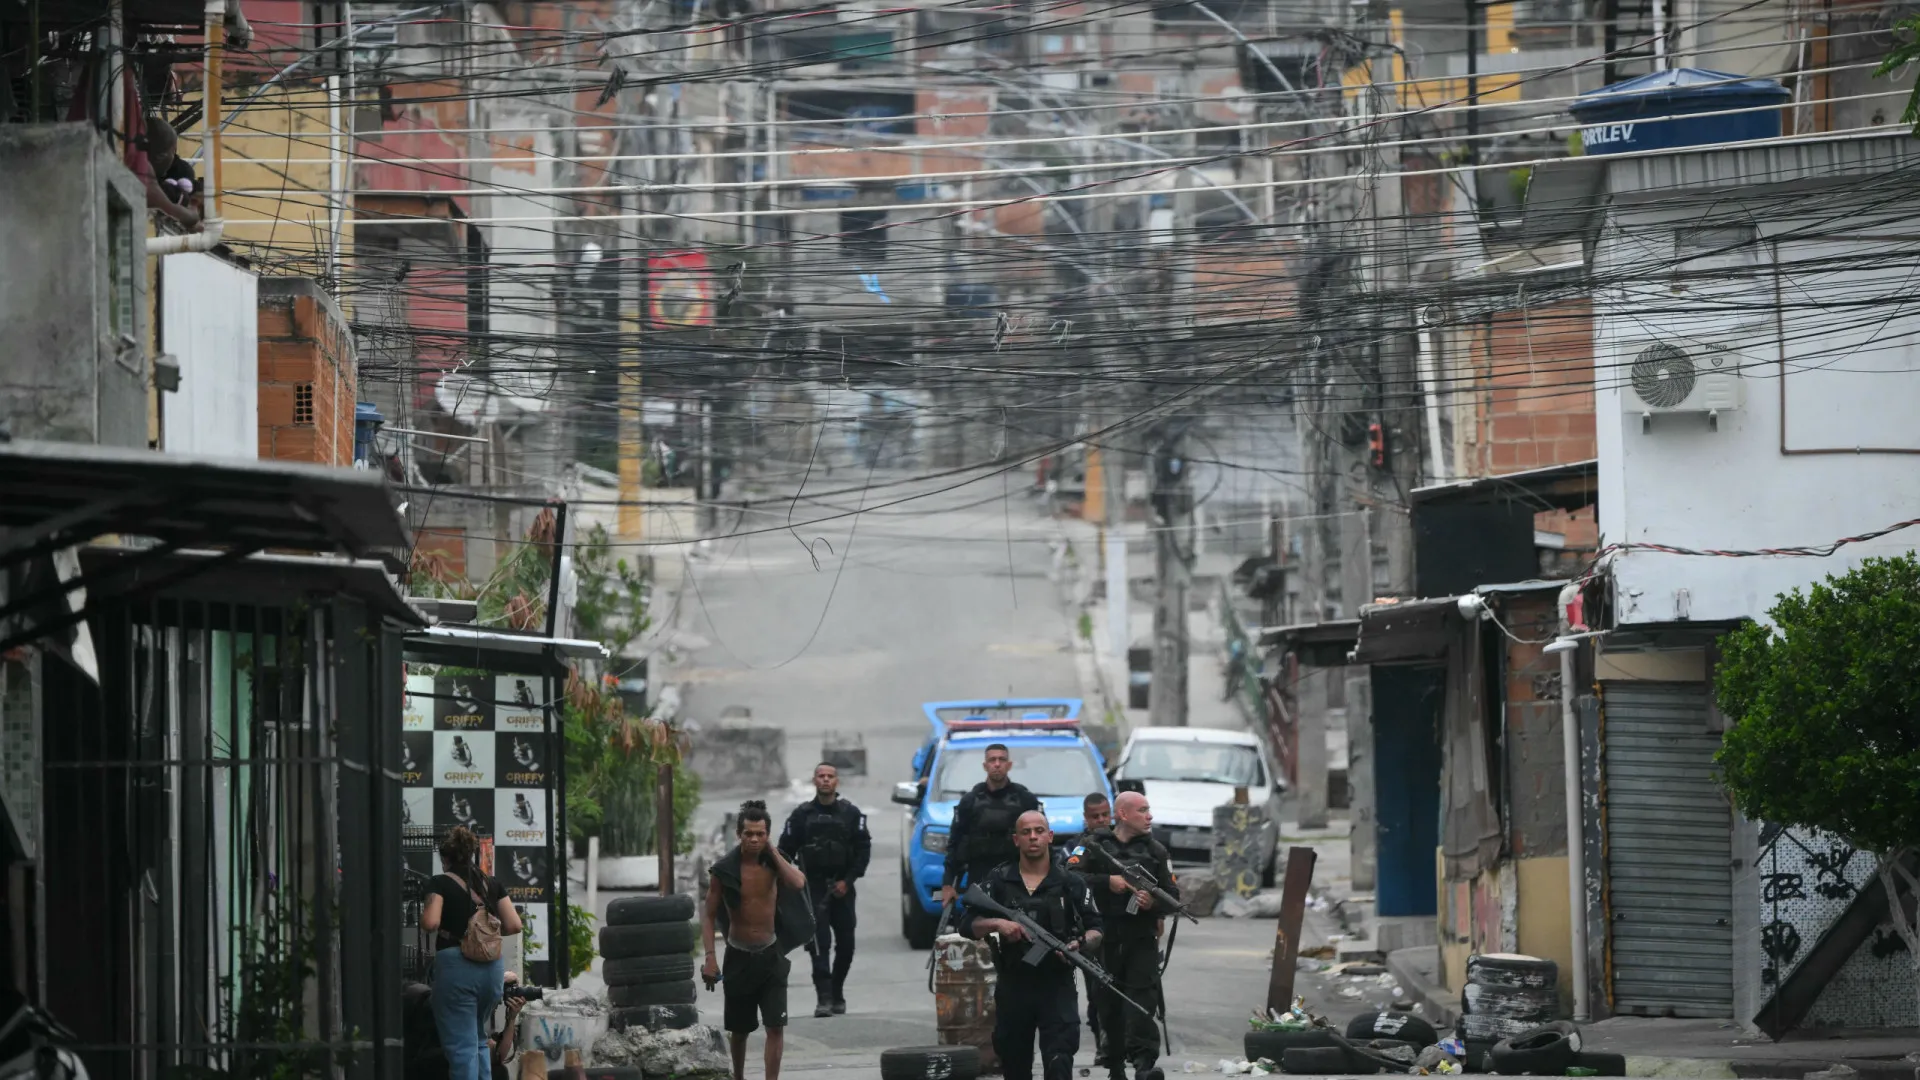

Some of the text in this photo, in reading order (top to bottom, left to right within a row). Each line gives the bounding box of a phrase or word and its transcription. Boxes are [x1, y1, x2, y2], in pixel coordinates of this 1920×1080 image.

[444, 715, 484, 724] GRIFFY
[444, 772, 484, 781] GRIFFY
[506, 773, 545, 781] GRIFFY
[506, 830, 545, 838] GRIFFY
[506, 888, 544, 896] GRIFFY
